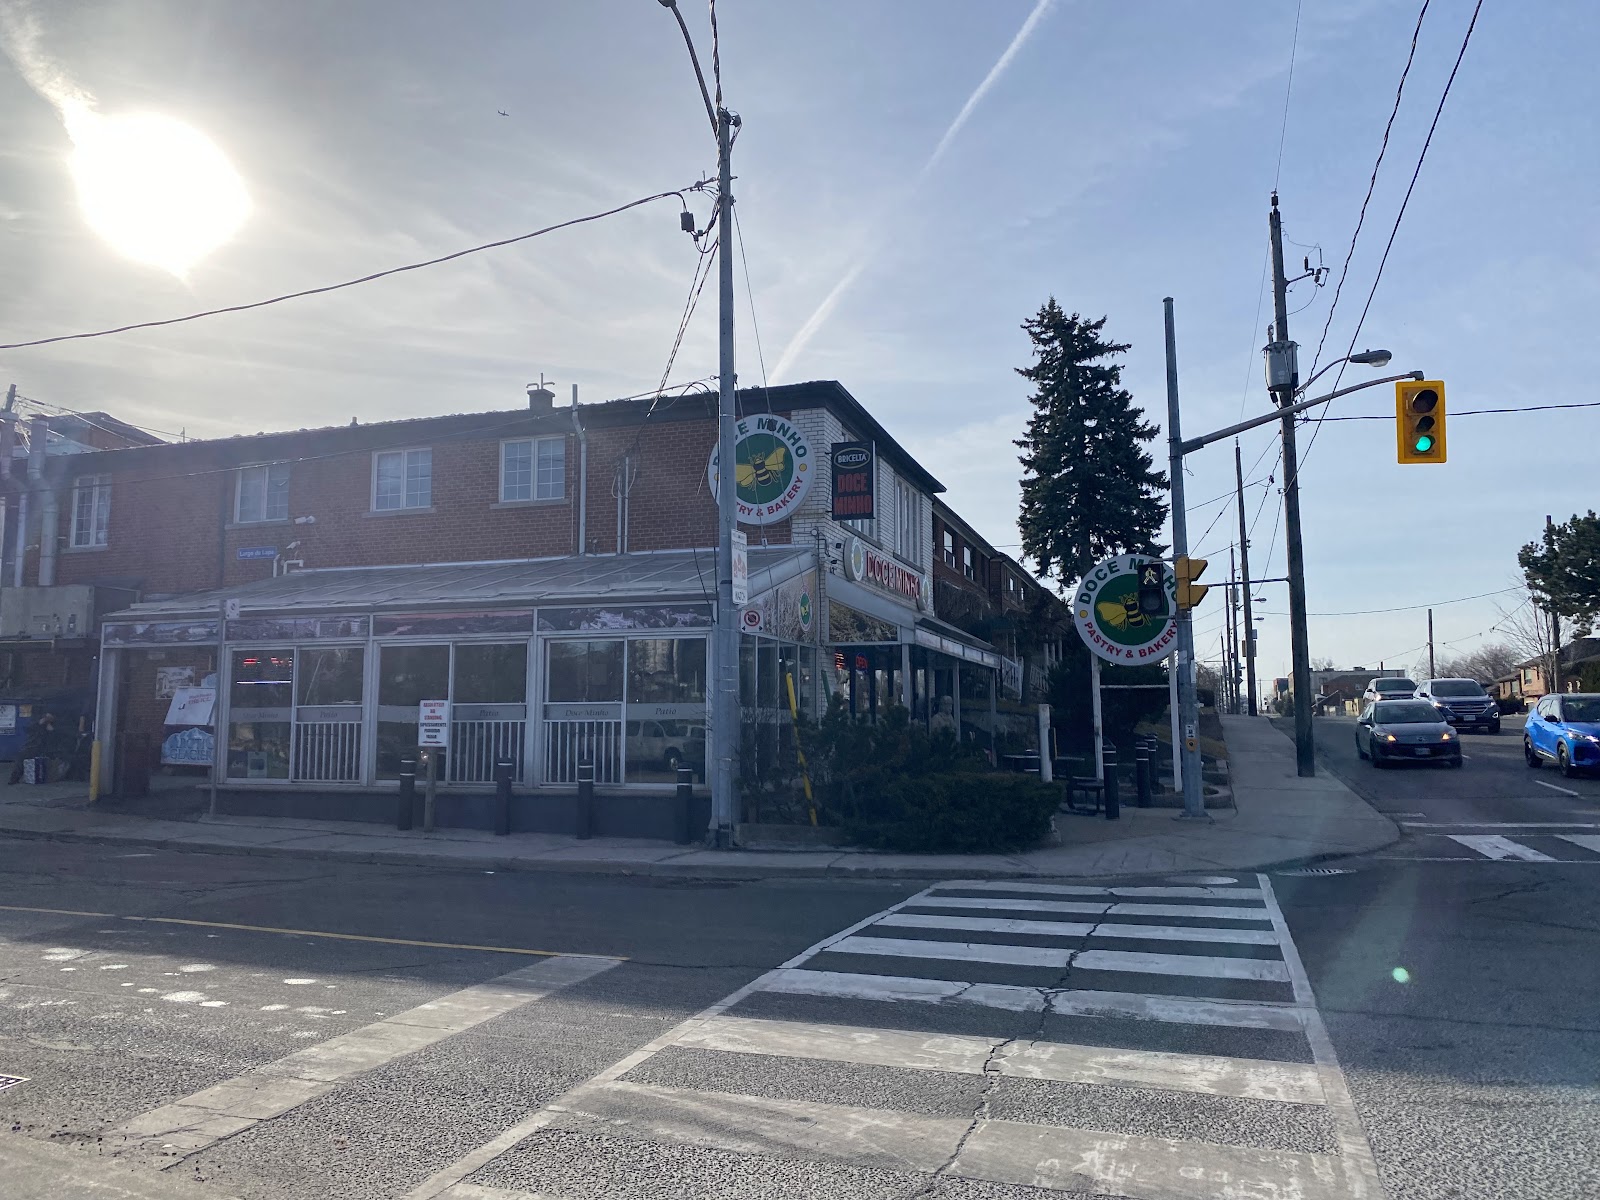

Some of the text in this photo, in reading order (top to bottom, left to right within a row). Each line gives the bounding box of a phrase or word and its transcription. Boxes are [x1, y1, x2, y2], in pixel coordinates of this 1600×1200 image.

[837, 453, 867, 464] BRICELTA
[837, 472, 868, 493] DOCE
[756, 508, 764, 517] &
[767, 476, 803, 515] BAKERY
[834, 494, 872, 515] MINHO
[866, 550, 894, 588] DOCE
[894, 566, 921, 599] MINHO
[1078, 561, 1120, 605] DOCE
[1084, 620, 1178, 658] PASTRY & BAKERY
[479, 709, 499, 717] Patio
[655, 707, 677, 716] Patio
